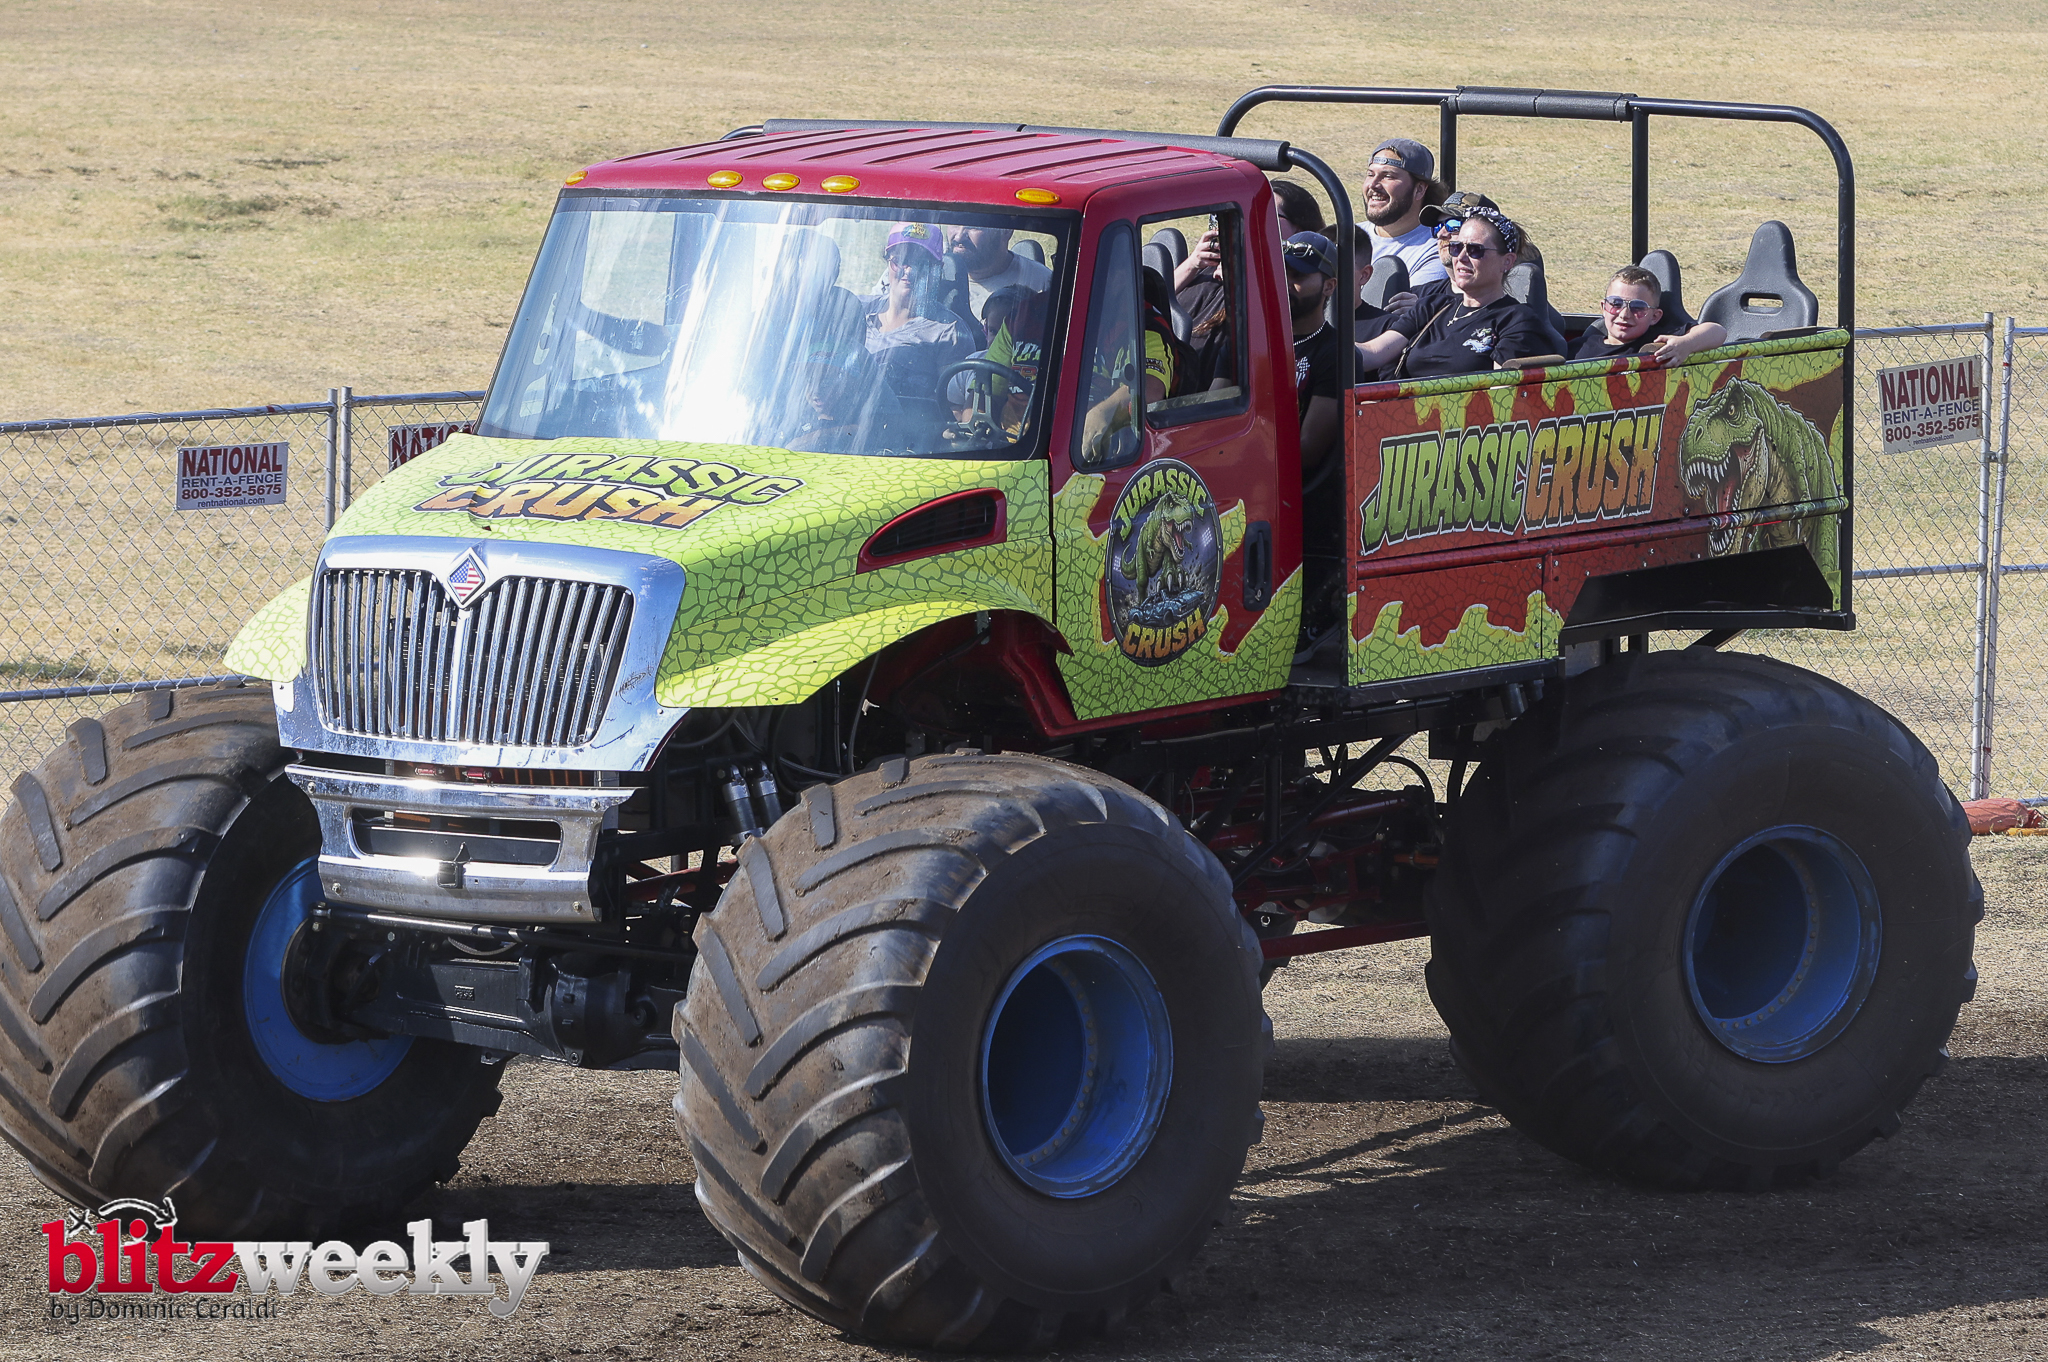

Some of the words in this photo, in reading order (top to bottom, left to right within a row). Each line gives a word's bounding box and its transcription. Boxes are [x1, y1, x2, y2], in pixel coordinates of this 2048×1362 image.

[1880, 359, 1979, 411] NATIONAL
[1884, 399, 1979, 425] RENT-A-FENCE
[1885, 414, 1980, 443] 800-352-5675
[181, 473, 283, 488] RENT-A-FENCE
[182, 445, 282, 477] NATIONAL
[435, 453, 807, 507] JURASSIC
[1360, 421, 1530, 556] JURASSIC
[1521, 404, 1666, 531] CRUSH
[181, 484, 282, 499] 800-352-5675
[197, 497, 265, 508] rentnational.com
[412, 482, 725, 529] CRUSH
[1114, 468, 1208, 542] JURASSIC
[1122, 608, 1207, 659] CRUSH
